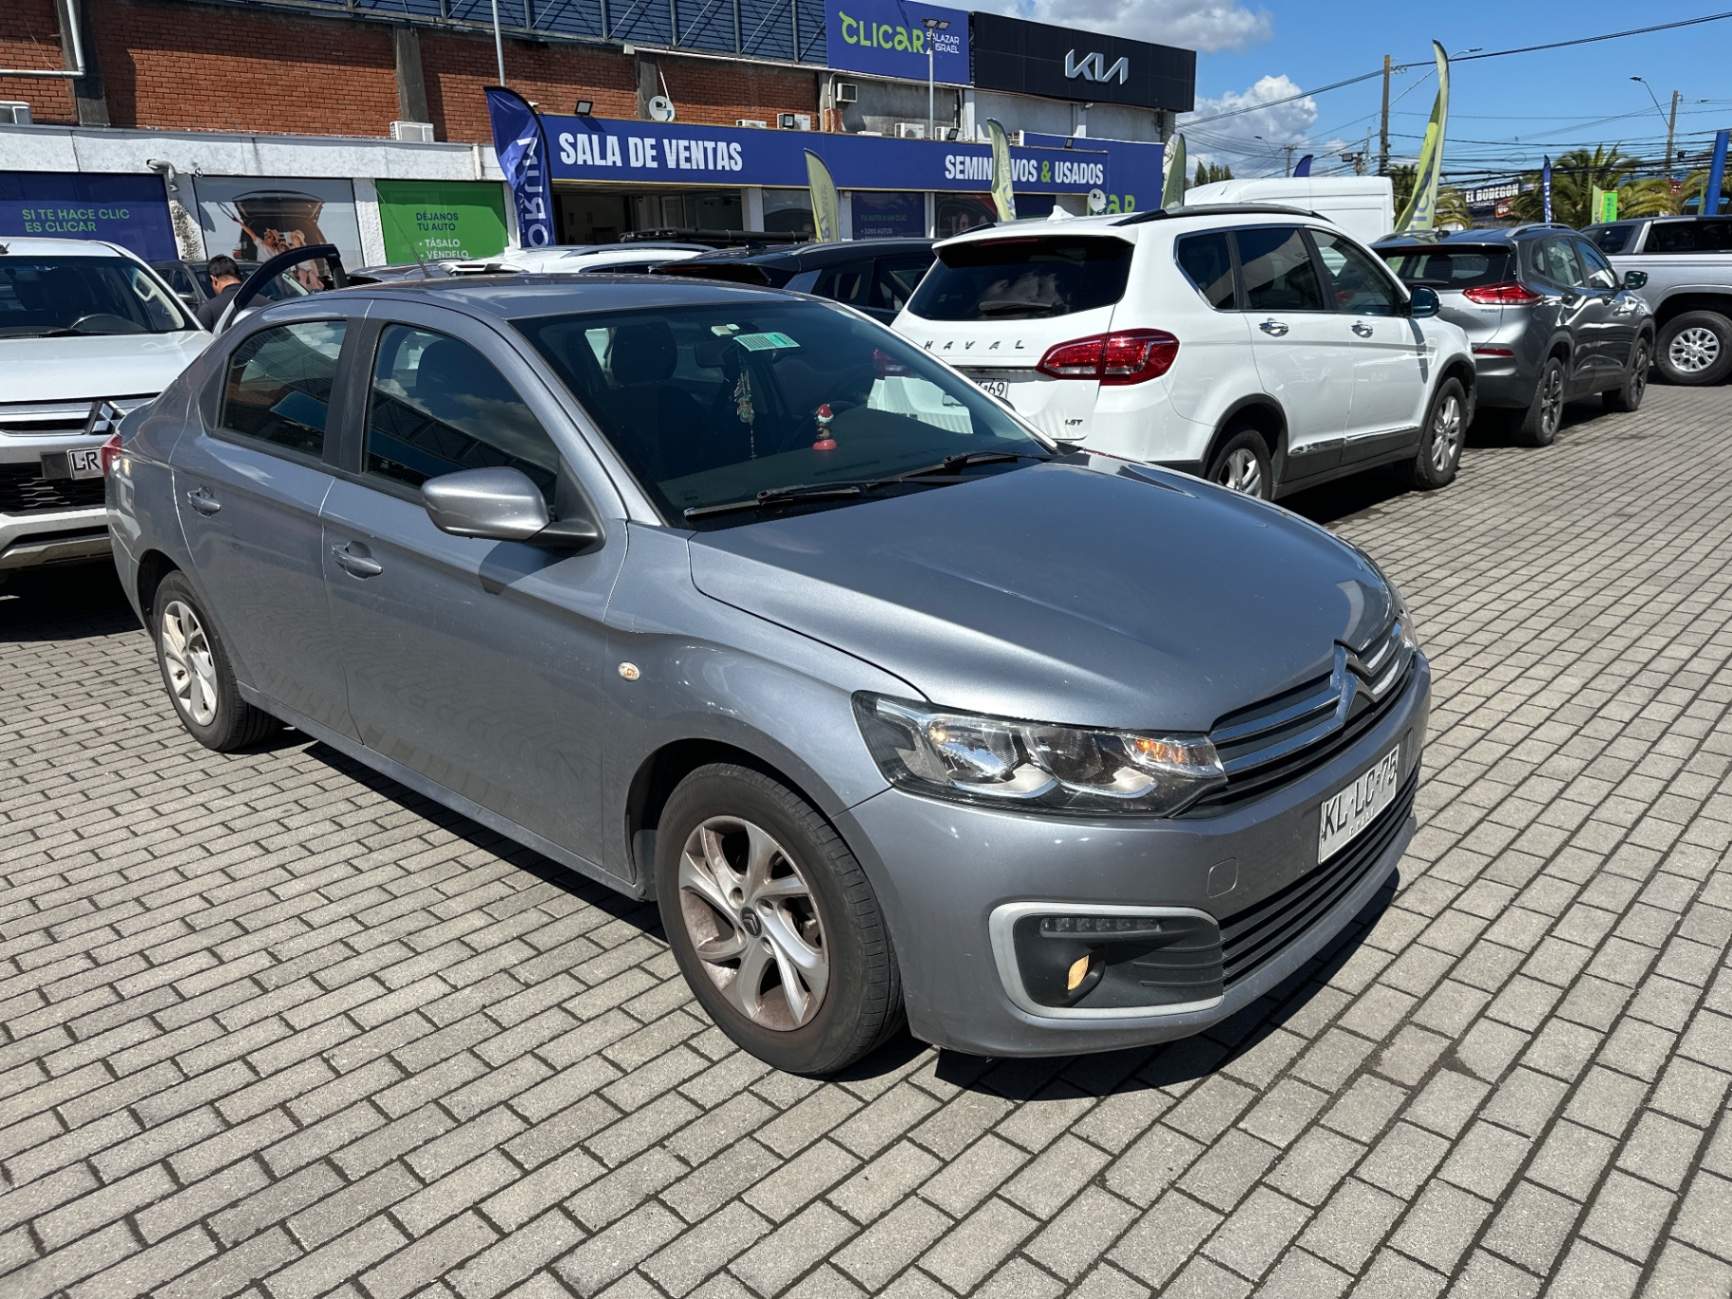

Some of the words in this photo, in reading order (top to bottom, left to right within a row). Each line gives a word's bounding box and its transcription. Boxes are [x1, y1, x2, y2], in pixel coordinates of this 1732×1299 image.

[1065, 49, 1129, 85] KIA
[558, 132, 623, 167] SALA
[628, 137, 658, 168] DE
[663, 139, 743, 171] VENTAS
[945, 155, 1038, 182] SEMINVOS
[1040, 160, 1051, 183] &
[1055, 161, 1104, 184] USADOS
[1466, 191, 1475, 203] EL
[22, 209, 36, 220] SI
[38, 209, 55, 220] TE
[58, 209, 96, 220] HACE
[98, 209, 130, 219] CLIC
[25, 222, 42, 232] ES
[45, 221, 97, 232] CLICAR
[417, 223, 429, 231] TU
[431, 223, 456, 231] AUTO
[924, 339, 1025, 350] HAVAL
